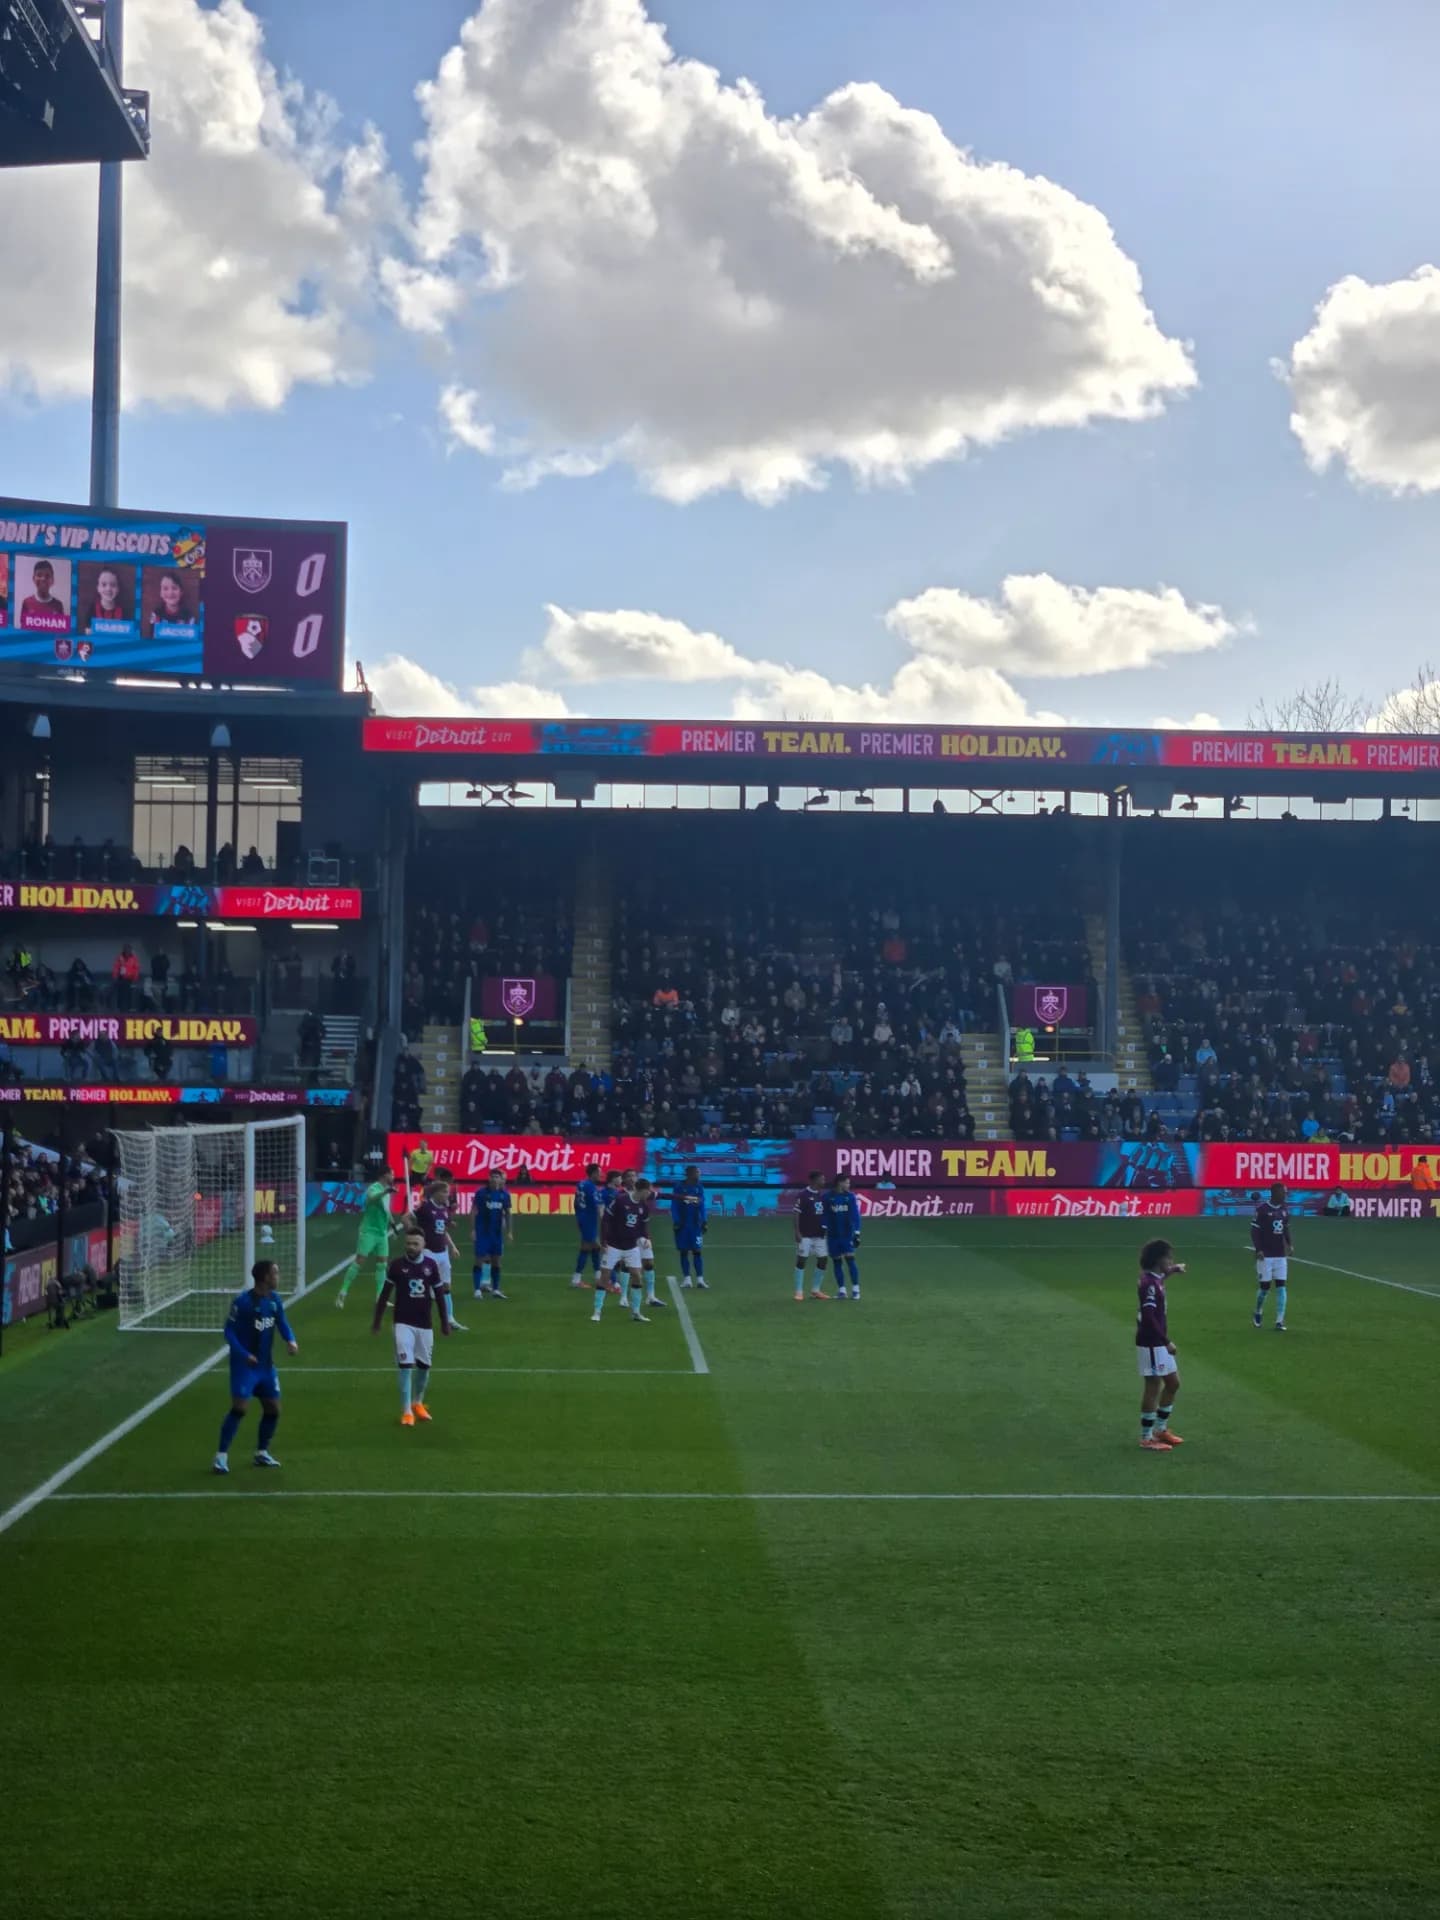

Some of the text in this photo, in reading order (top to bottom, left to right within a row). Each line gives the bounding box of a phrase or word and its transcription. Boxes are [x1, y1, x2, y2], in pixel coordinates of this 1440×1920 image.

[59, 526, 90, 549] VIP
[91, 528, 171, 556] MASCOTS
[296, 553, 326, 597] 0
[25, 616, 67, 629] ROHAN
[293, 614, 323, 658] 0
[415, 724, 488, 748] Detroit
[681, 730, 1067, 759] PREMIER TEAM. PREMIER HOLIDAY.
[1192, 741, 1439, 767] PREMIER TEAM. PREMIER
[20, 886, 139, 910] HOLIDAY.
[263, 892, 330, 914] Detroit
[125, 1018, 247, 1041] HOLIDAY.
[23, 1088, 66, 1101] TEAM.
[70, 1088, 106, 1102] PREMIER
[108, 1089, 172, 1102] HOLIDAY.
[466, 1139, 575, 1175] Detroit
[836, 1148, 1056, 1177] PREMIER TEAM.
[1235, 1152, 1330, 1180] PREMIER
[1016, 1202, 1049, 1215] VISIT
